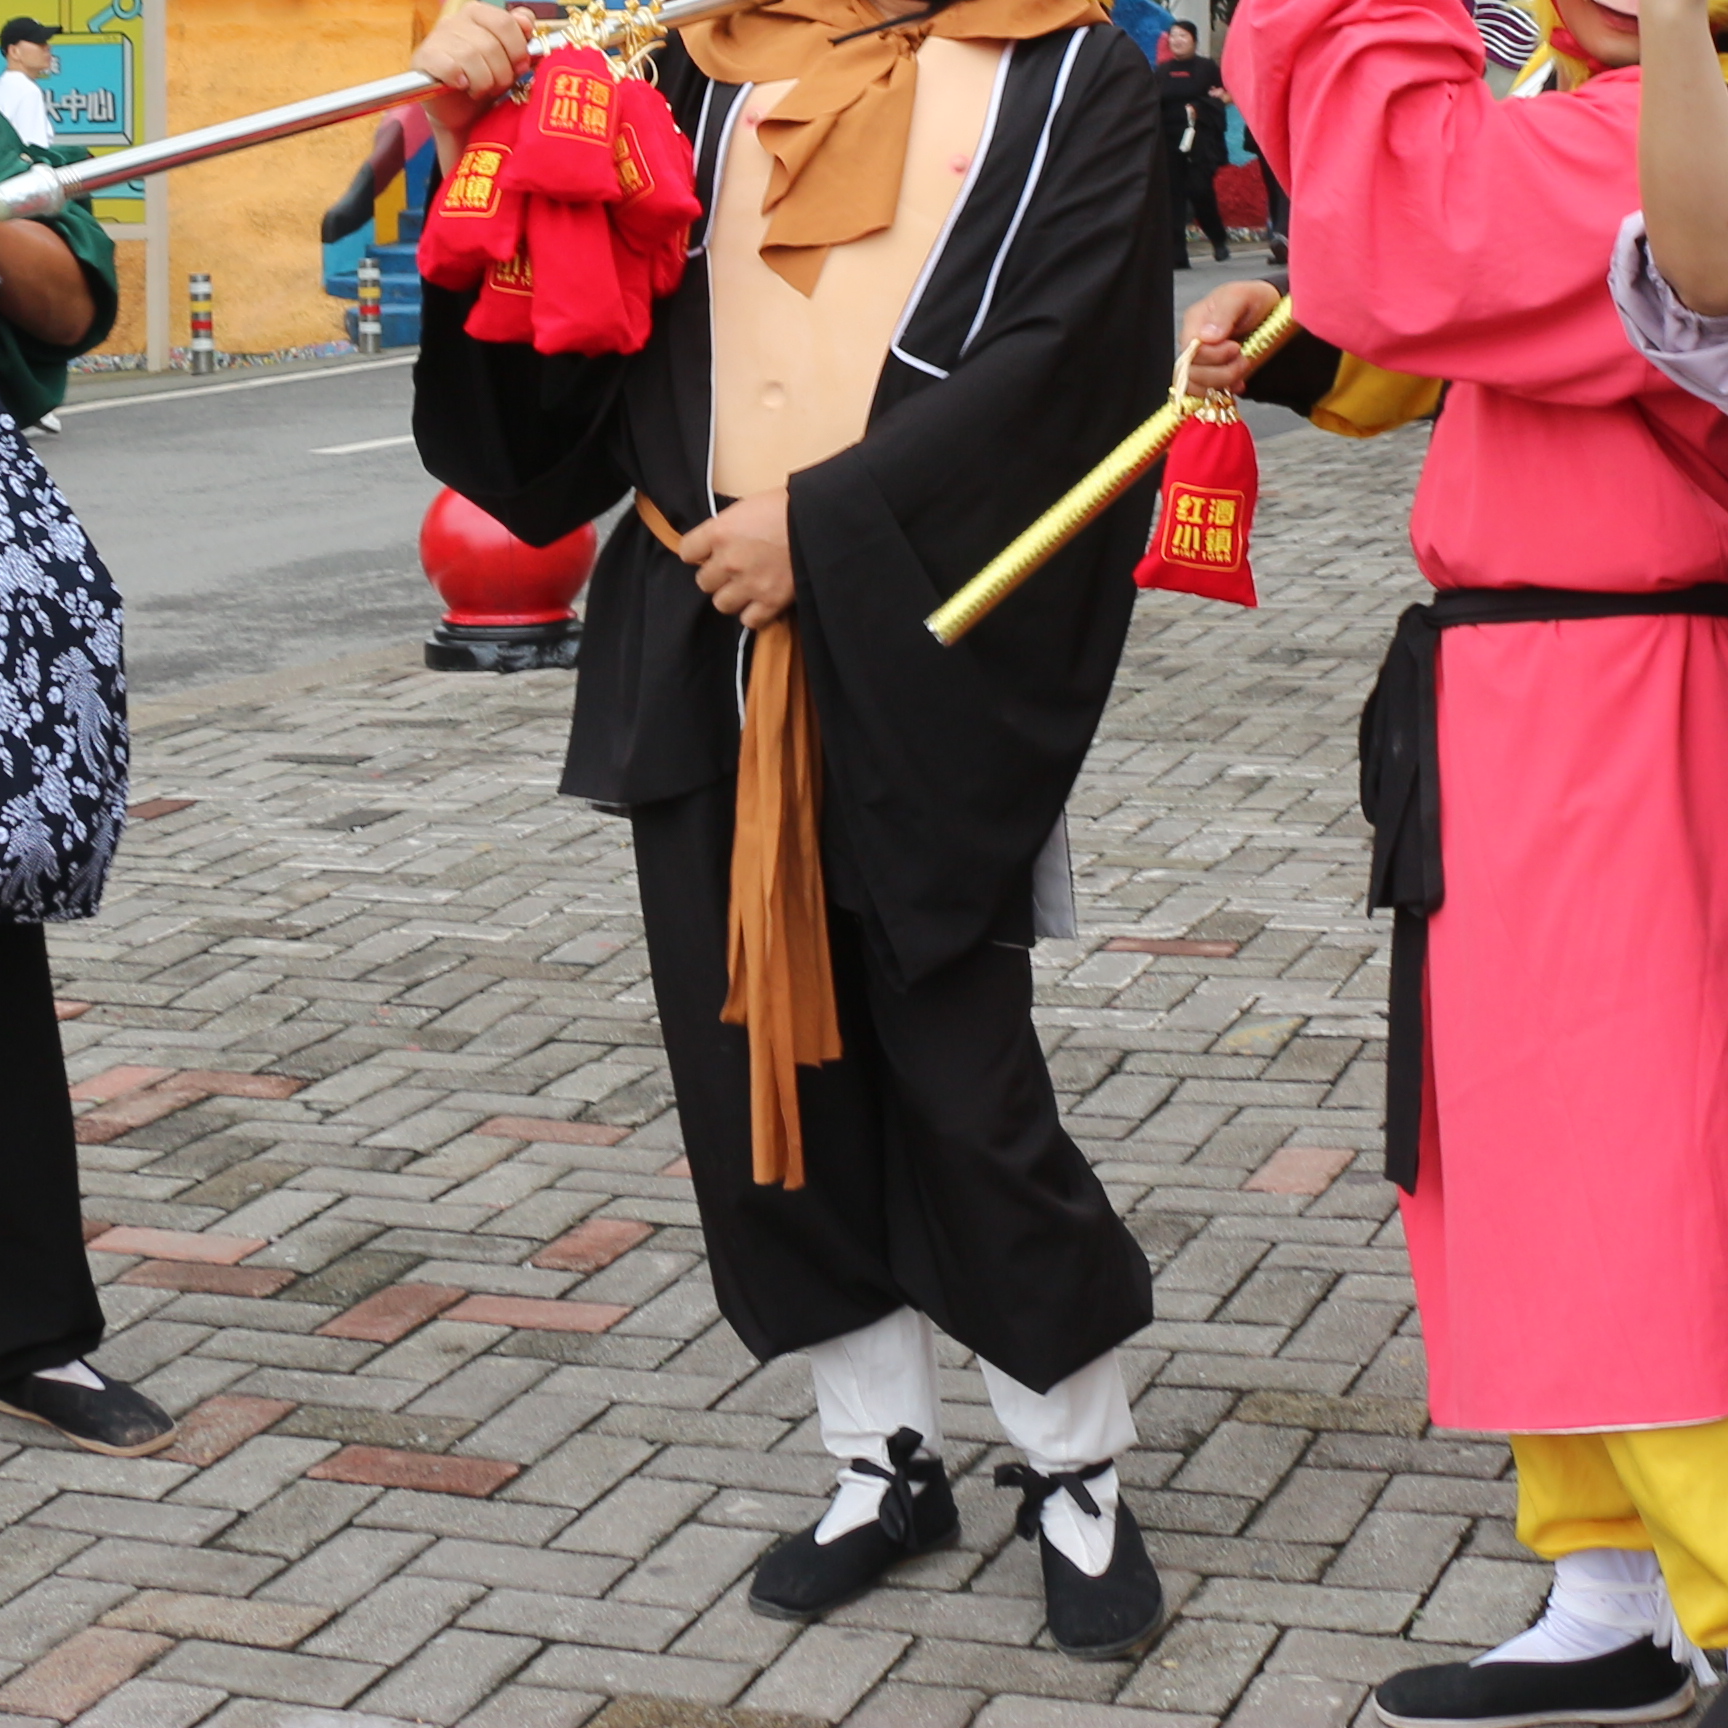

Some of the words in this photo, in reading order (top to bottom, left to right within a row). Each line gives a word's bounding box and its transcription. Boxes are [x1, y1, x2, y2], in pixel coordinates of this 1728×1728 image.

[554, 74, 611, 108] 红酒
[551, 98, 609, 130] 小镇
[1175, 493, 1237, 527] 红酒
[1172, 523, 1234, 554] 小镇
